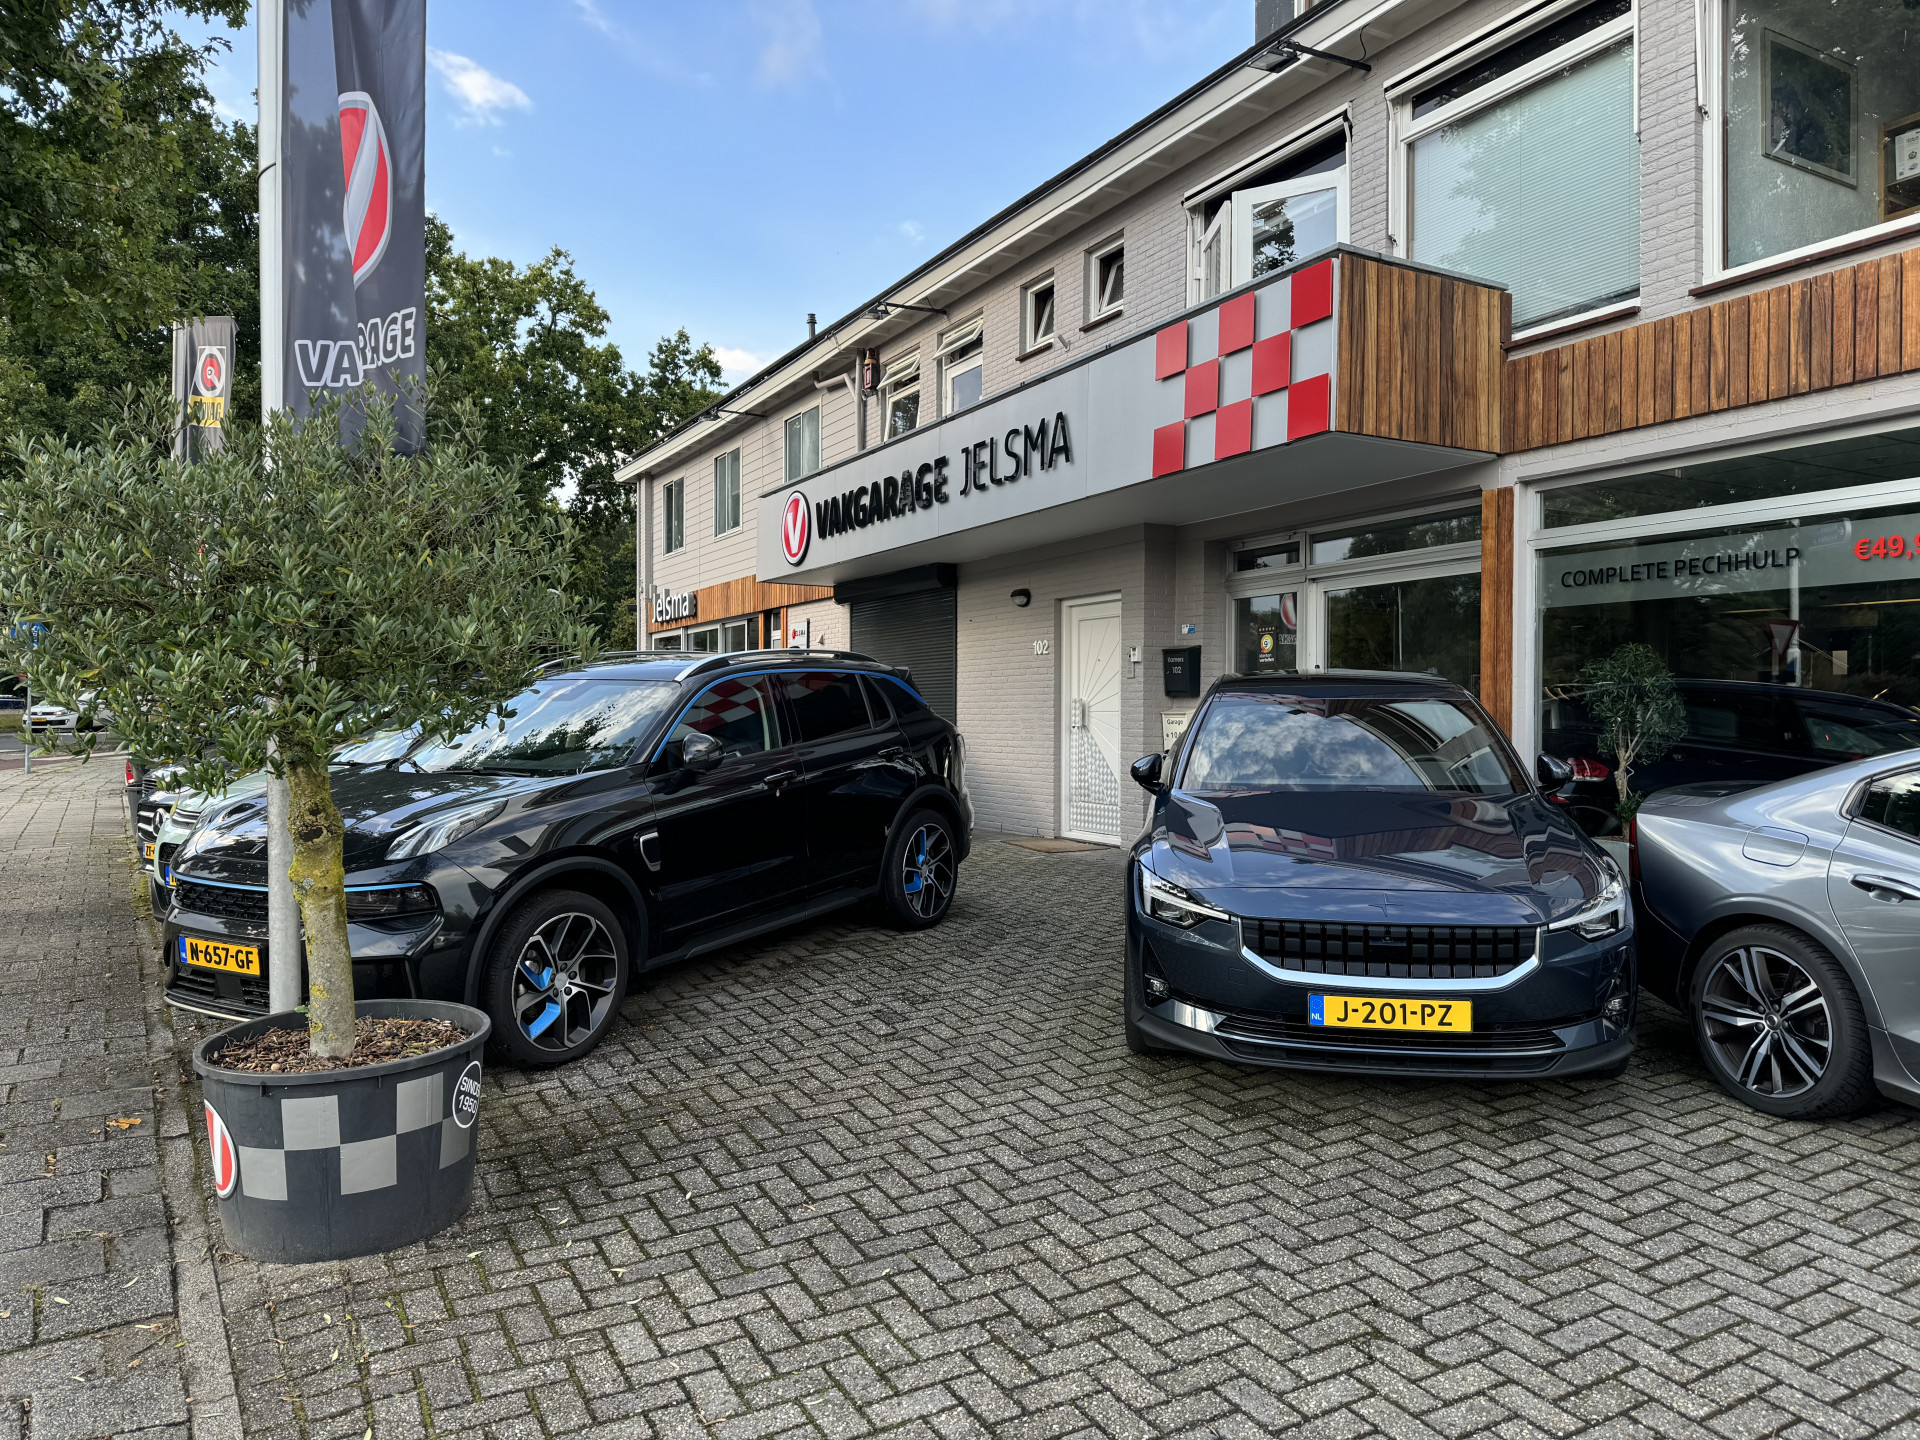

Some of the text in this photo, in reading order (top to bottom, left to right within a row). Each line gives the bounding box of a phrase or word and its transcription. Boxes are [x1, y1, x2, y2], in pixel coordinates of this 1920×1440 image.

[816, 411, 1072, 540] VAKGARAGE JELSMA
[1561, 547, 1801, 588] COMPLETE PECHHULP
[1032, 639, 1049, 655] 102
[1171, 666, 1182, 674] 102
[1166, 718, 1184, 726] Garage
[189, 942, 254, 970] N-657-GF
[1311, 1000, 1453, 1027] NL J-201-PZ
[458, 1094, 478, 1114] 1950
